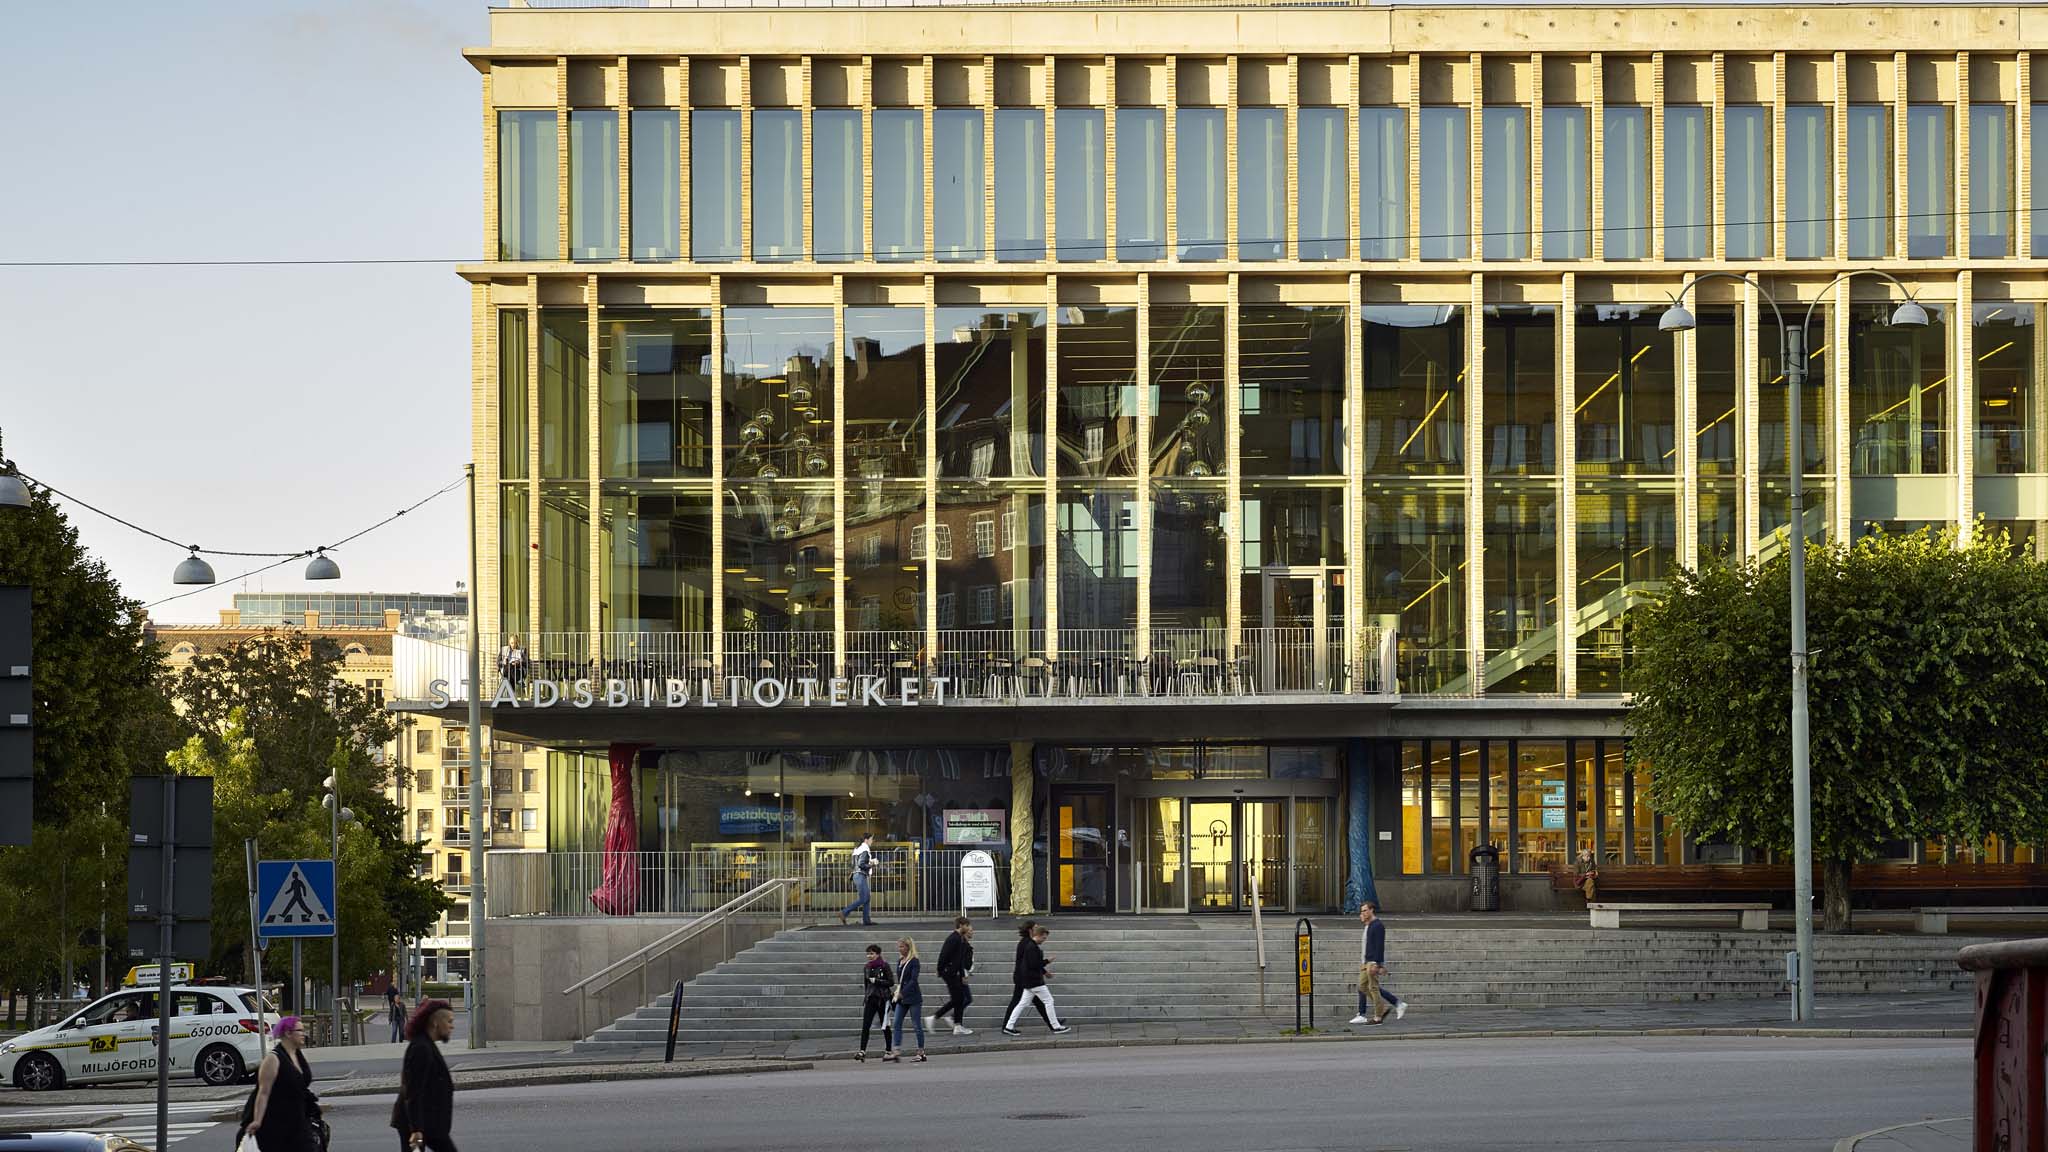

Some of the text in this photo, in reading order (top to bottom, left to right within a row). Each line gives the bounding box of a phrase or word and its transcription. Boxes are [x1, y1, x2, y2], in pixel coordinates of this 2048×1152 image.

[190, 1025, 239, 1038] 650 000
[90, 1035, 117, 1049] Taxi
[82, 1057, 176, 1074] MILJÖFORDN
